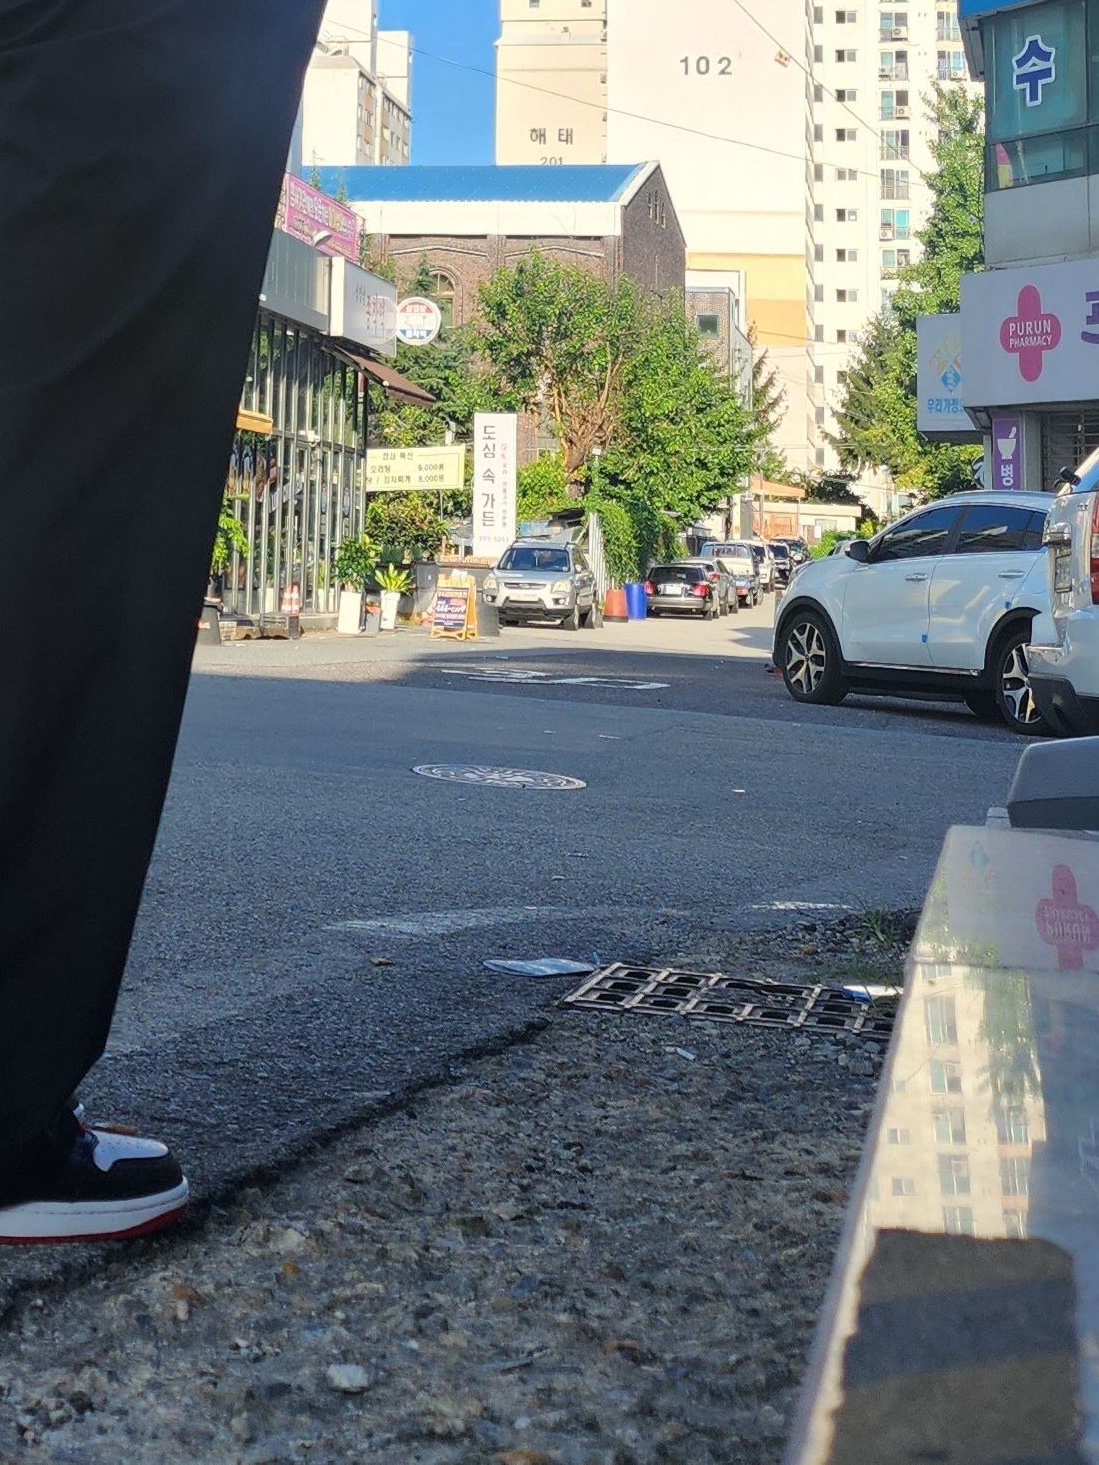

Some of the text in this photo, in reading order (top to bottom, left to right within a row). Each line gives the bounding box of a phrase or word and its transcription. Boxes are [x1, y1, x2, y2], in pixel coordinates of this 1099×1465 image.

[679, 55, 733, 76] 102
[1013, 35, 1056, 107] 수
[1009, 319, 1051, 336] PURUN
[1009, 334, 1053, 348] PHARMACY
[927, 398, 963, 413] 우리가정
[481, 425, 497, 527] 도심 속 가든
